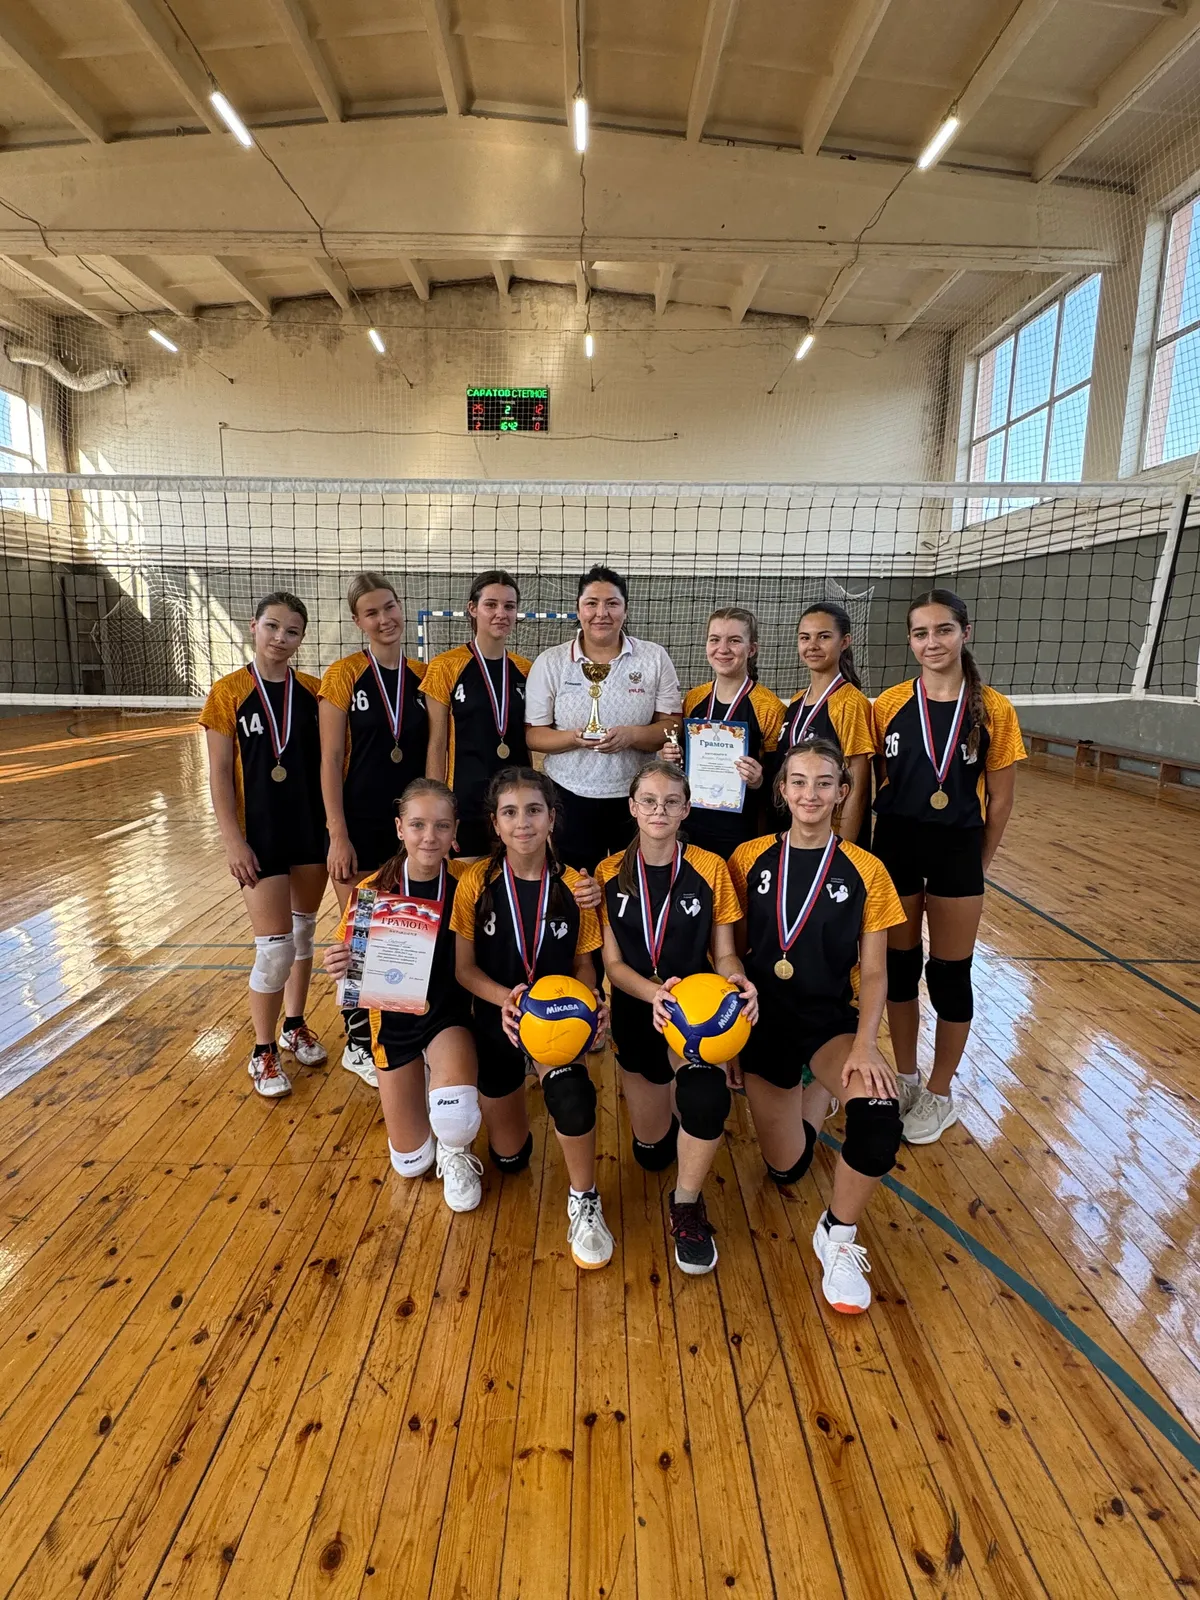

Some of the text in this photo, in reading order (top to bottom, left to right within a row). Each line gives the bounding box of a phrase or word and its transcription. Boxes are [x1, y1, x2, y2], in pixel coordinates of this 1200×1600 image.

[467, 389, 547, 398] САРАТОВ СТЕПНОЕ
[504, 405, 511, 414] 2
[535, 404, 544, 414] 12
[475, 421, 481, 430] 2
[534, 422, 540, 431] 0
[455, 683, 466, 703] 4
[239, 712, 264, 738] 14
[699, 739, 734, 749] Грамота
[885, 732, 900, 758] 26
[757, 869, 772, 895] 3
[616, 892, 630, 918] 7
[380, 917, 429, 931] ГРАМОТА
[483, 911, 497, 936] 8
